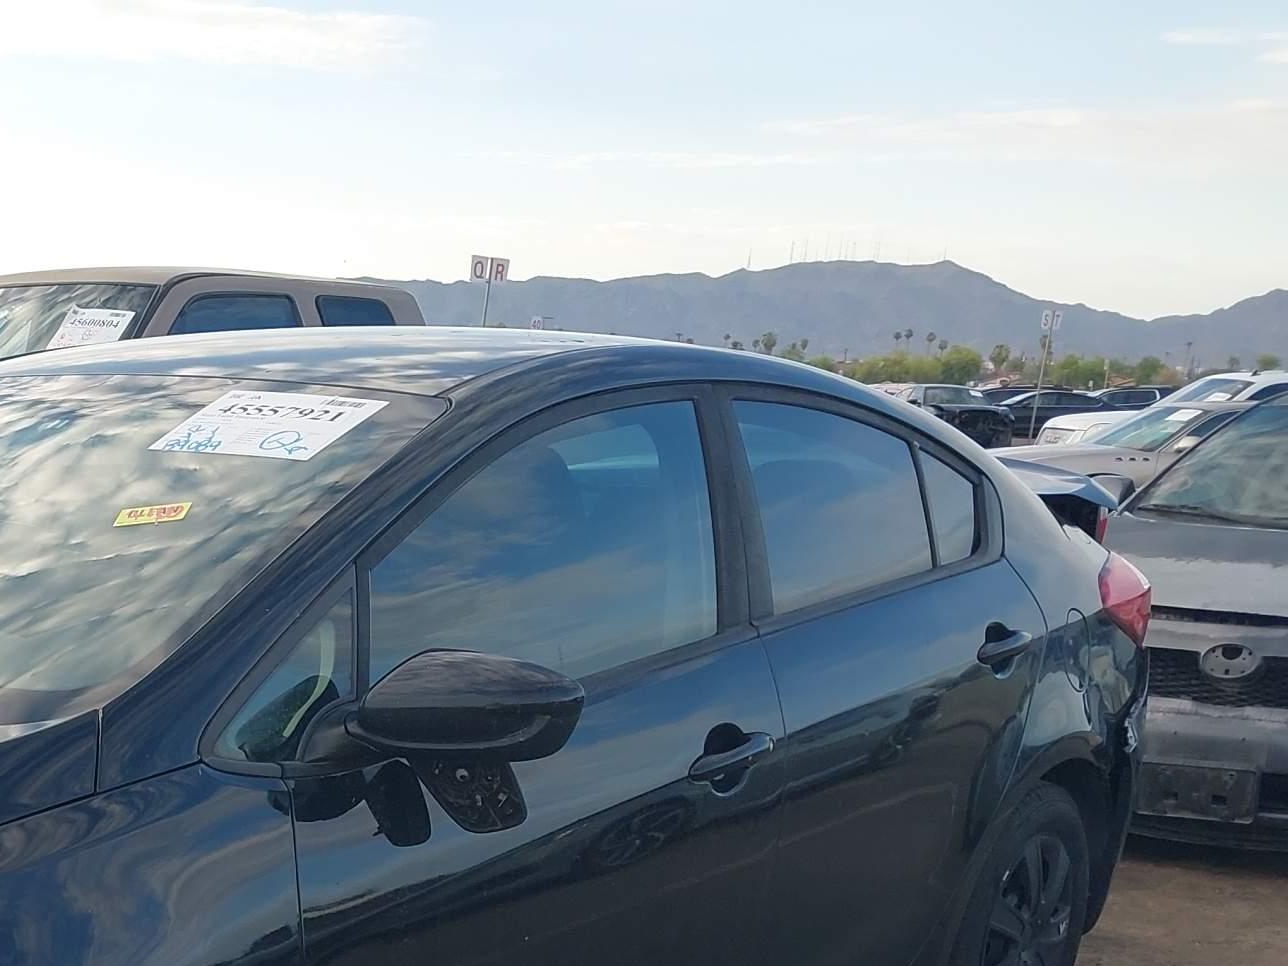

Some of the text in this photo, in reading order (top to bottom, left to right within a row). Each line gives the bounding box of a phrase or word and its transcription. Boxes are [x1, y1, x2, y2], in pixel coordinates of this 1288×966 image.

[473, 260, 485, 280] Q
[494, 263, 505, 281] R
[218, 402, 346, 422] 45557921
